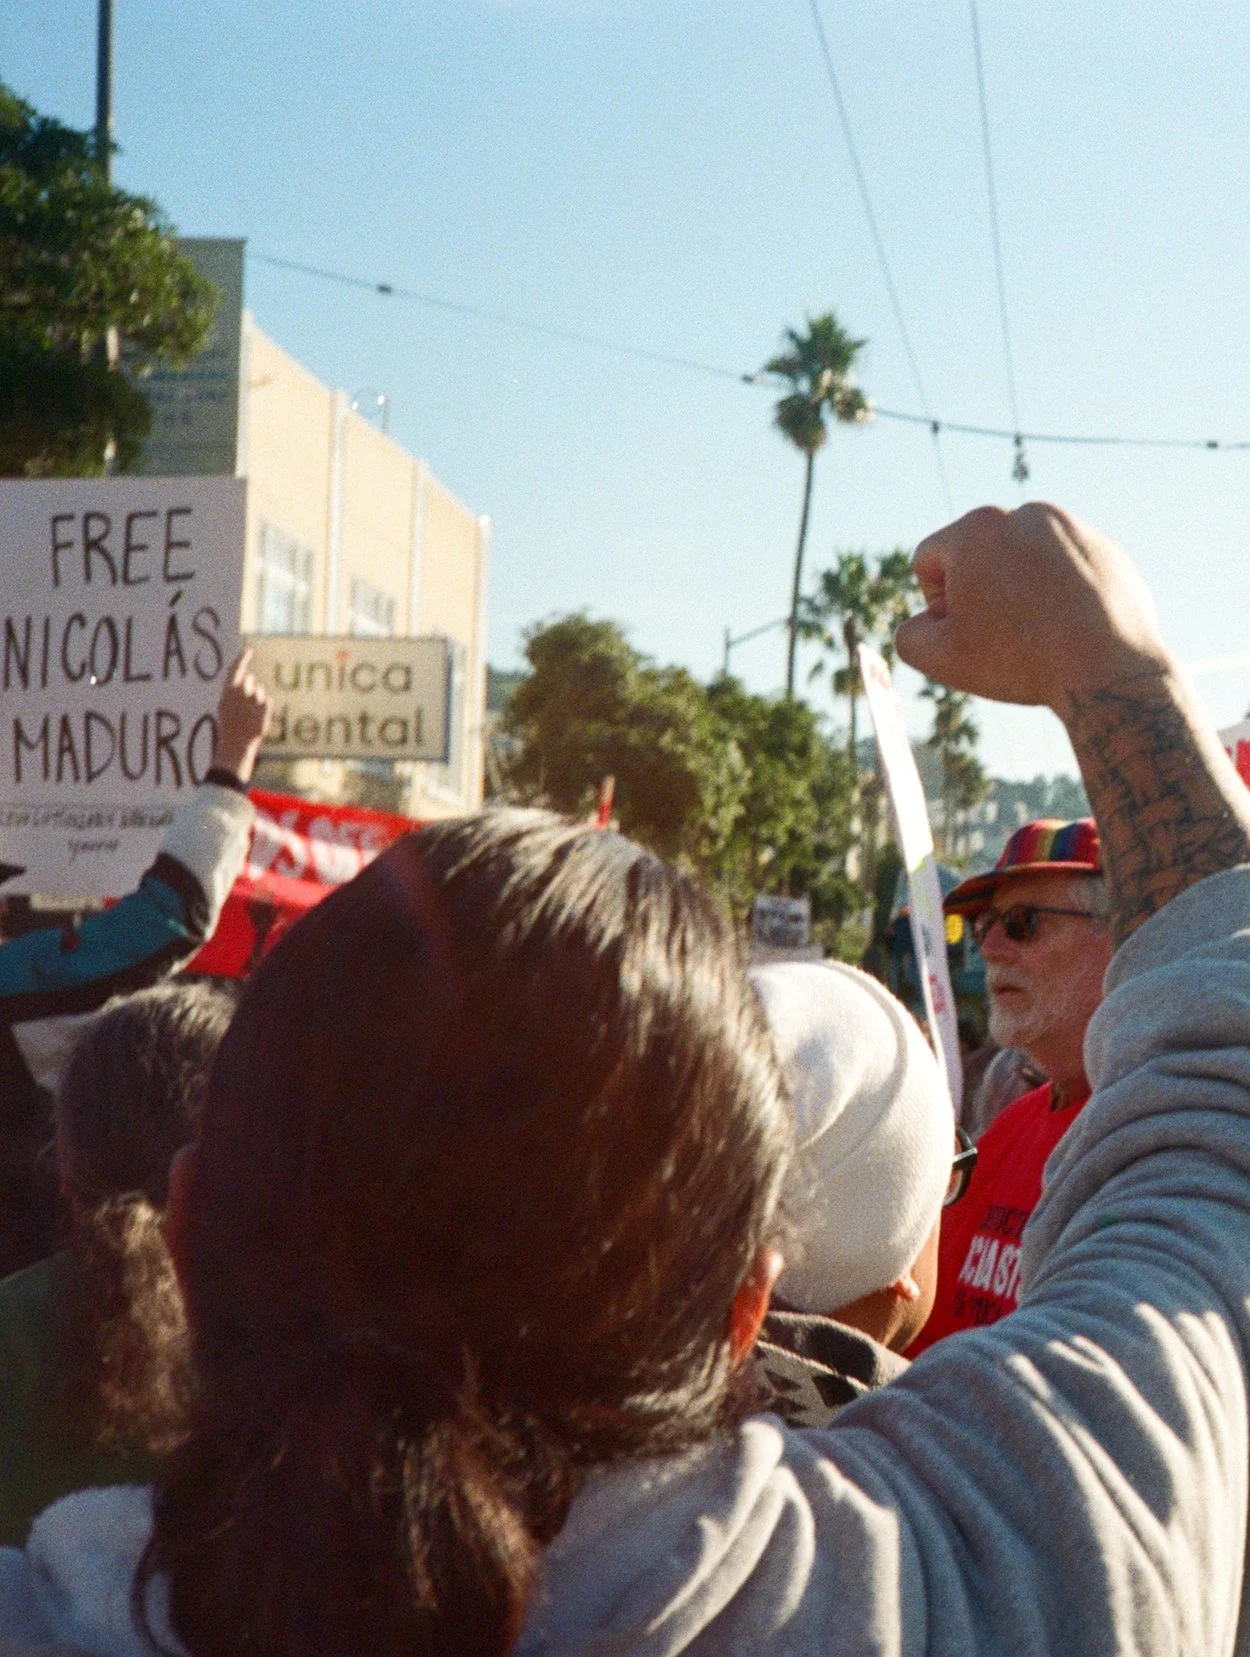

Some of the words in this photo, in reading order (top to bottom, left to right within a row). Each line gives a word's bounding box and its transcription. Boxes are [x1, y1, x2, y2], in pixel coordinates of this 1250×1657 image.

[50, 507, 196, 589] FREE
[2, 590, 224, 691] NICOLÁS
[272, 648, 413, 694] unica
[13, 709, 218, 788] MADURO
[265, 704, 425, 748] dental
